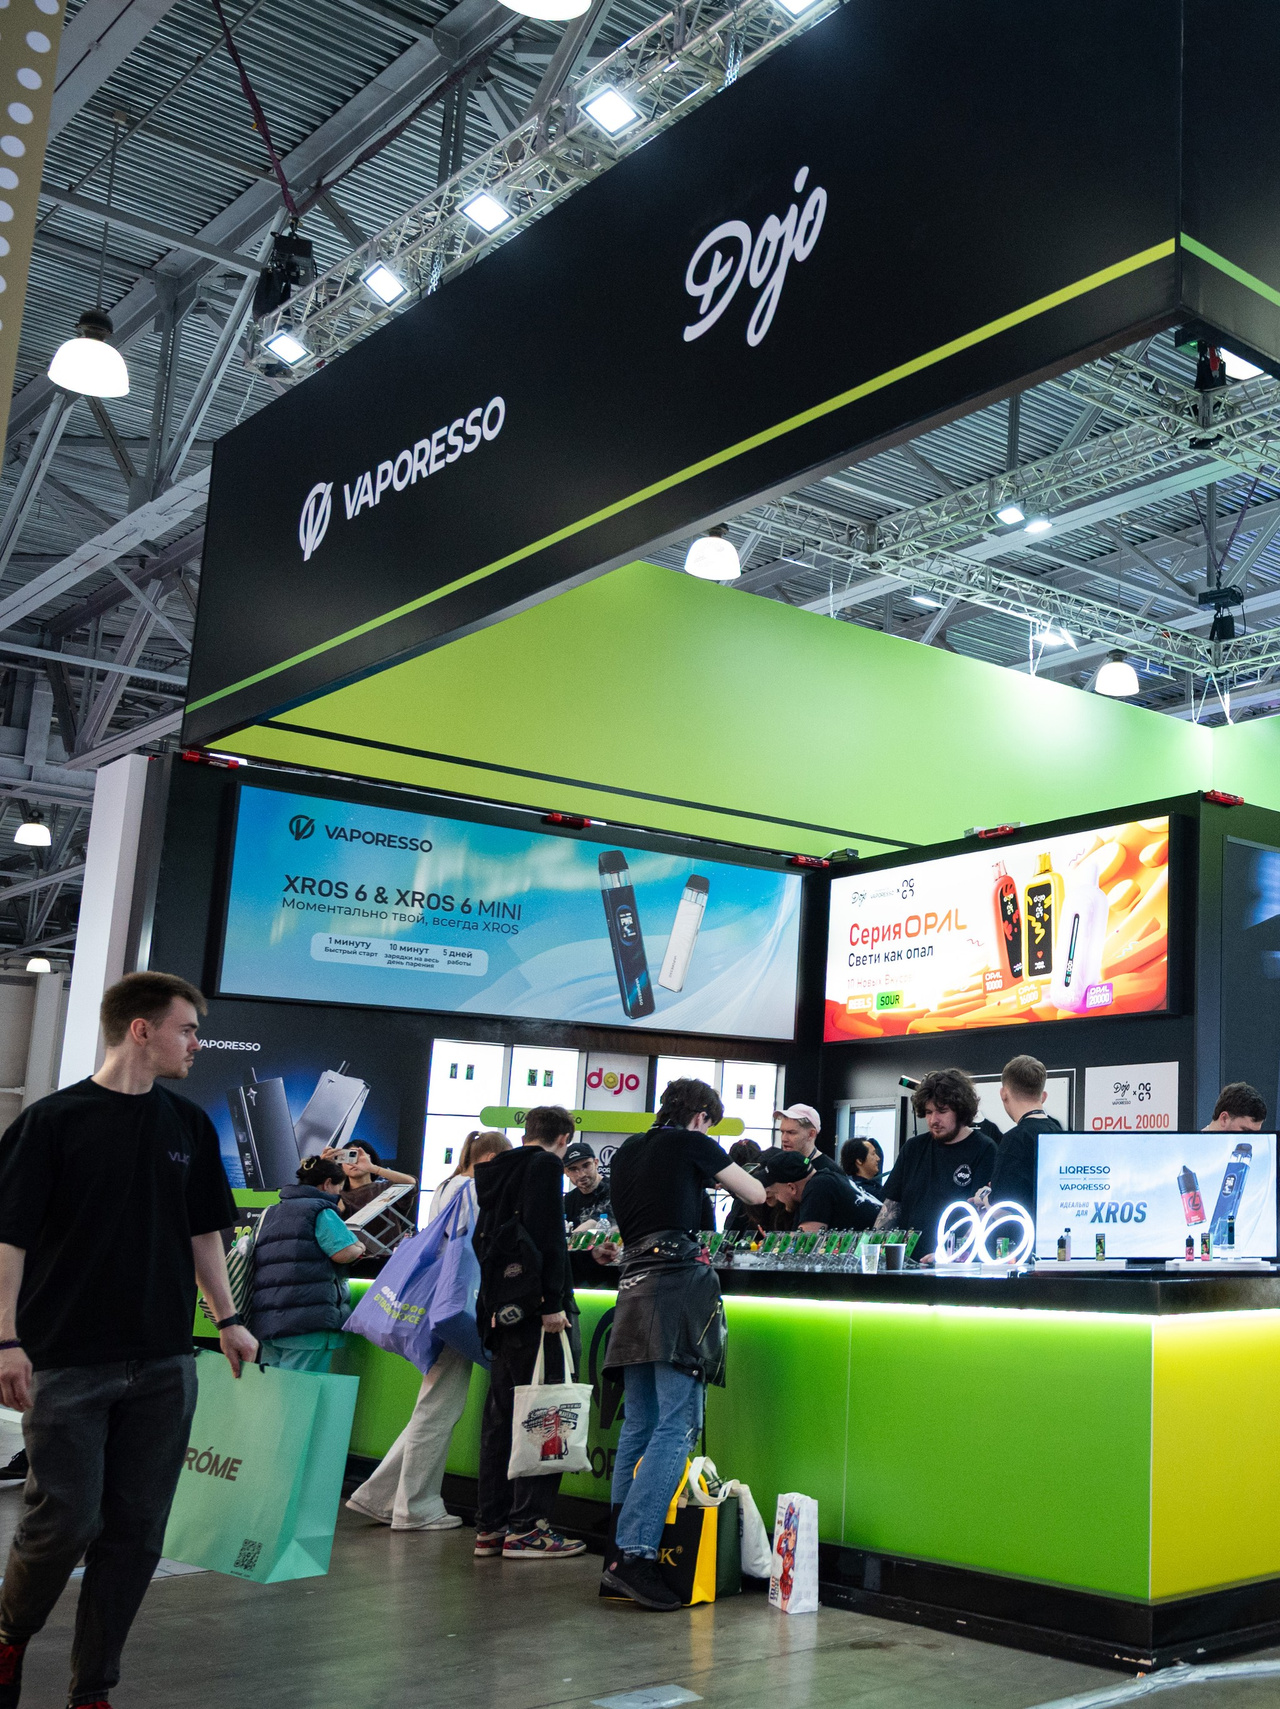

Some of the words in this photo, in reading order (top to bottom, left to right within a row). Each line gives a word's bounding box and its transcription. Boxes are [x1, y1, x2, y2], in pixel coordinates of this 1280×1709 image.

[683, 165, 828, 348] Dojo
[343, 396, 506, 520] VAPORESSO
[325, 824, 433, 853] VAPORESSO
[283, 874, 349, 899] XROS
[355, 884, 368, 901] 6
[374, 886, 389, 906] &
[394, 888, 456, 913] XROS
[460, 897, 473, 915] 6
[478, 899, 522, 921] MINI
[281, 896, 388, 920] Моментально
[392, 912, 429, 926] твой,
[432, 917, 479, 931] всегда
[482, 920, 519, 935] XROS
[849, 923, 902, 950] Серия
[904, 907, 968, 938] OPAL
[334, 938, 372, 950] минуту
[389, 943, 398, 951] 10
[399, 944, 430, 955] минут
[324, 946, 357, 956] Быстрый
[442, 948, 448, 956] 5
[448, 949, 473, 959] дней
[848, 952, 881, 967] Свети
[883, 949, 903, 963] как
[906, 945, 934, 960] опал
[384, 953, 413, 962] зарядки
[386, 958, 404, 966] день
[405, 960, 435, 969] парения
[447, 959, 472, 967] работы
[985, 971, 1003, 981] OPAL
[1089, 984, 1110, 995] OPAL
[880, 994, 900, 1007] SOUR
[586, 1067, 640, 1096] dojo
[1113, 1081, 1130, 1098] Dojo
[1092, 1115, 1132, 1131] OPAL
[1135, 1113, 1170, 1129] 20000
[1059, 1165, 1111, 1175] LIQRESSO
[1059, 1183, 1111, 1191] VAPORESSO
[1059, 1201, 1090, 1209] ИДЕАЛЬНО
[1089, 1201, 1148, 1224] XROS
